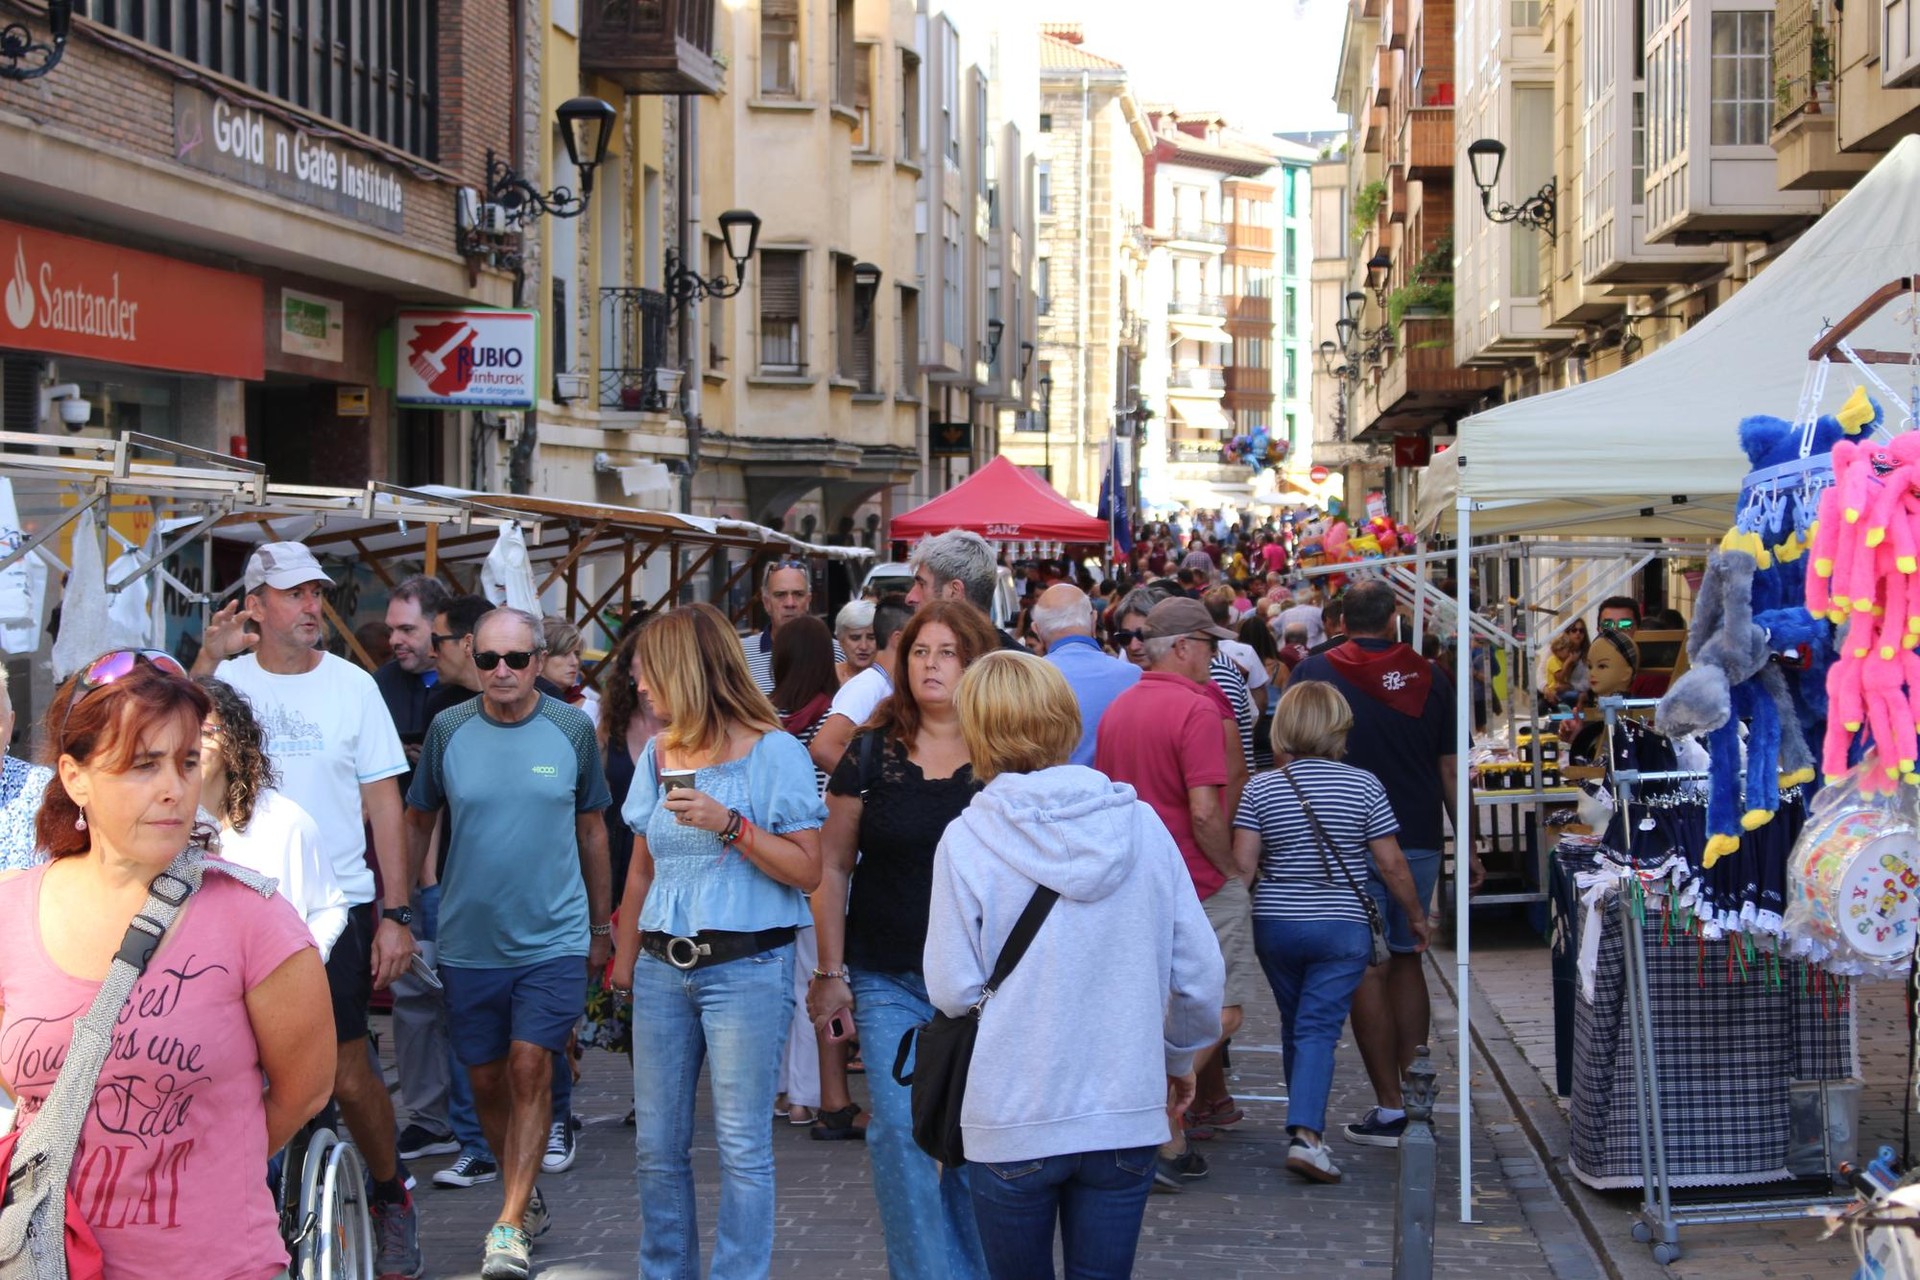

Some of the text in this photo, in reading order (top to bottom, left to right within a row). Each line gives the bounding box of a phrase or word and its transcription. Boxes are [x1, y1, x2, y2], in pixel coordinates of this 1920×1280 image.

[294, 130, 337, 190] Gate
[342, 153, 402, 213] Institute
[39, 261, 138, 341] Santander
[457, 347, 522, 369] RUBIO
[986, 524, 1020, 535] SANZ
[146, 1034, 205, 1073] une
[76, 1138, 194, 1230] OLAT
